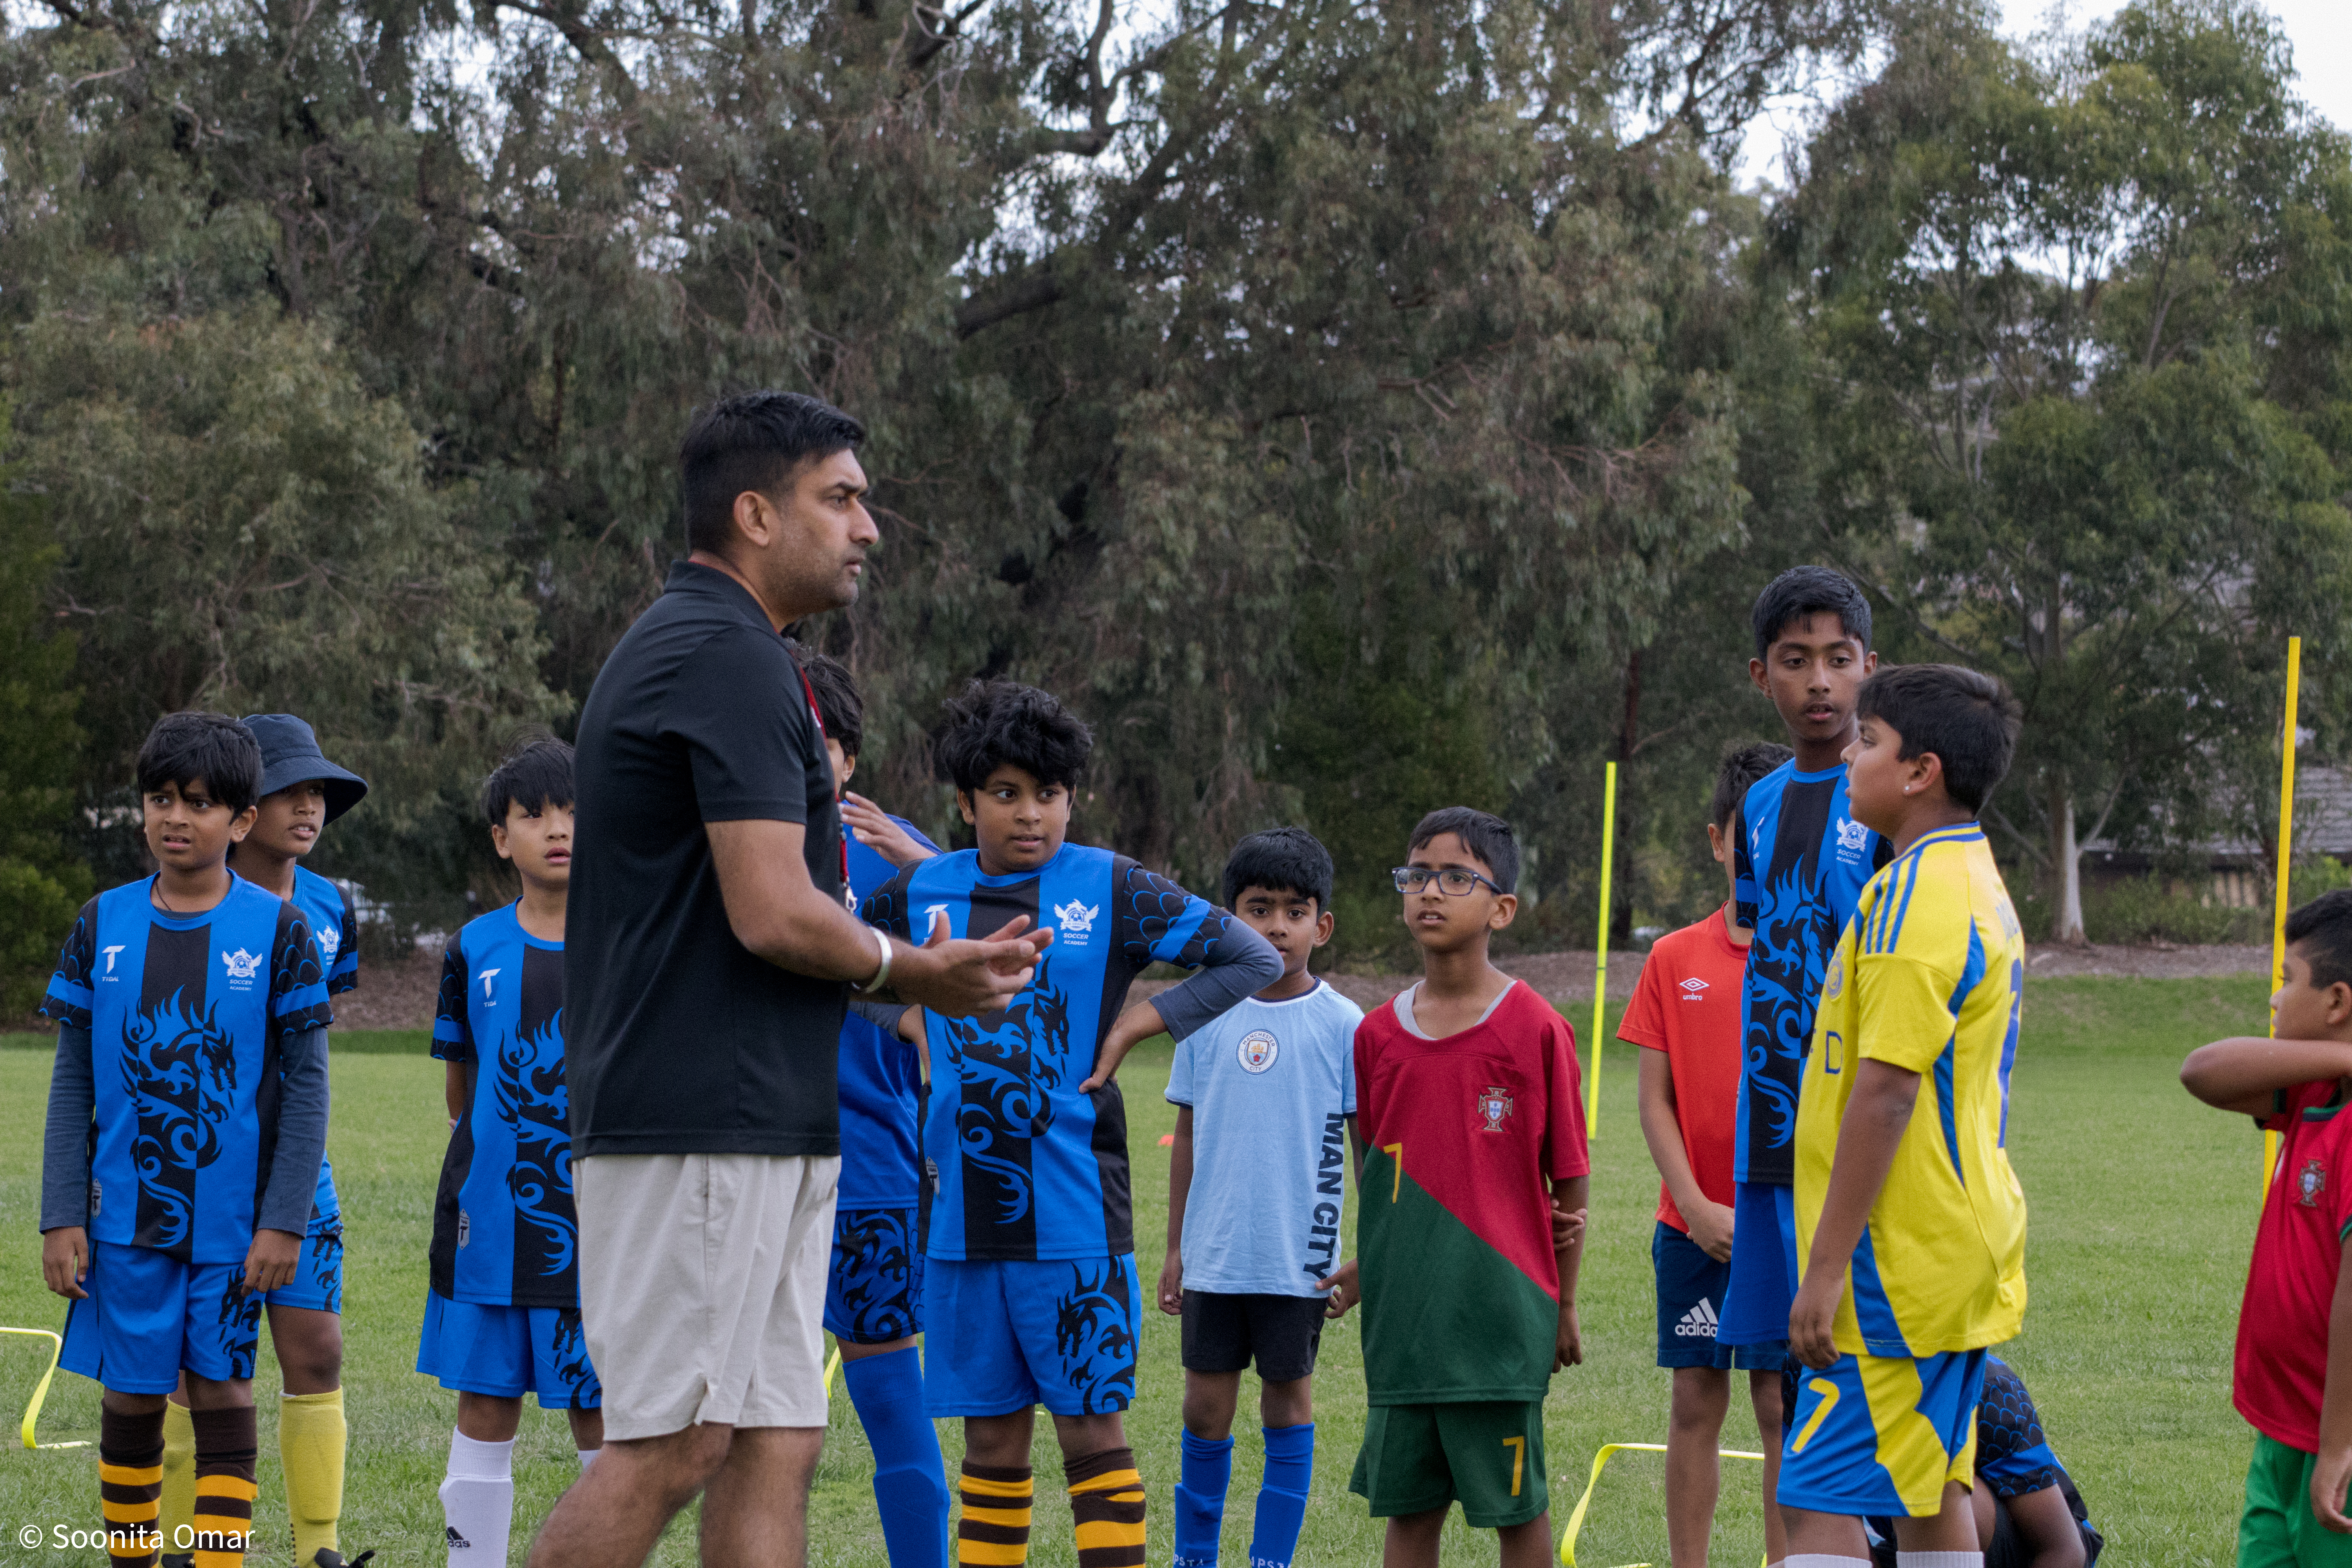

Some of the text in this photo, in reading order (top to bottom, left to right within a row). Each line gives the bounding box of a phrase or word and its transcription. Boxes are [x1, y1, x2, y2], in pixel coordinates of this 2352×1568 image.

[1836, 856, 1858, 866] ACADEMY
[1837, 849, 1861, 859] SOCCER
[1243, 1033, 1275, 1047] MANCHESTER
[1303, 1112, 1344, 1280] MAN CITY
[1383, 1142, 1402, 1203] 7
[1791, 1377, 1841, 1453] 7
[1503, 1436, 1524, 1496] 7
